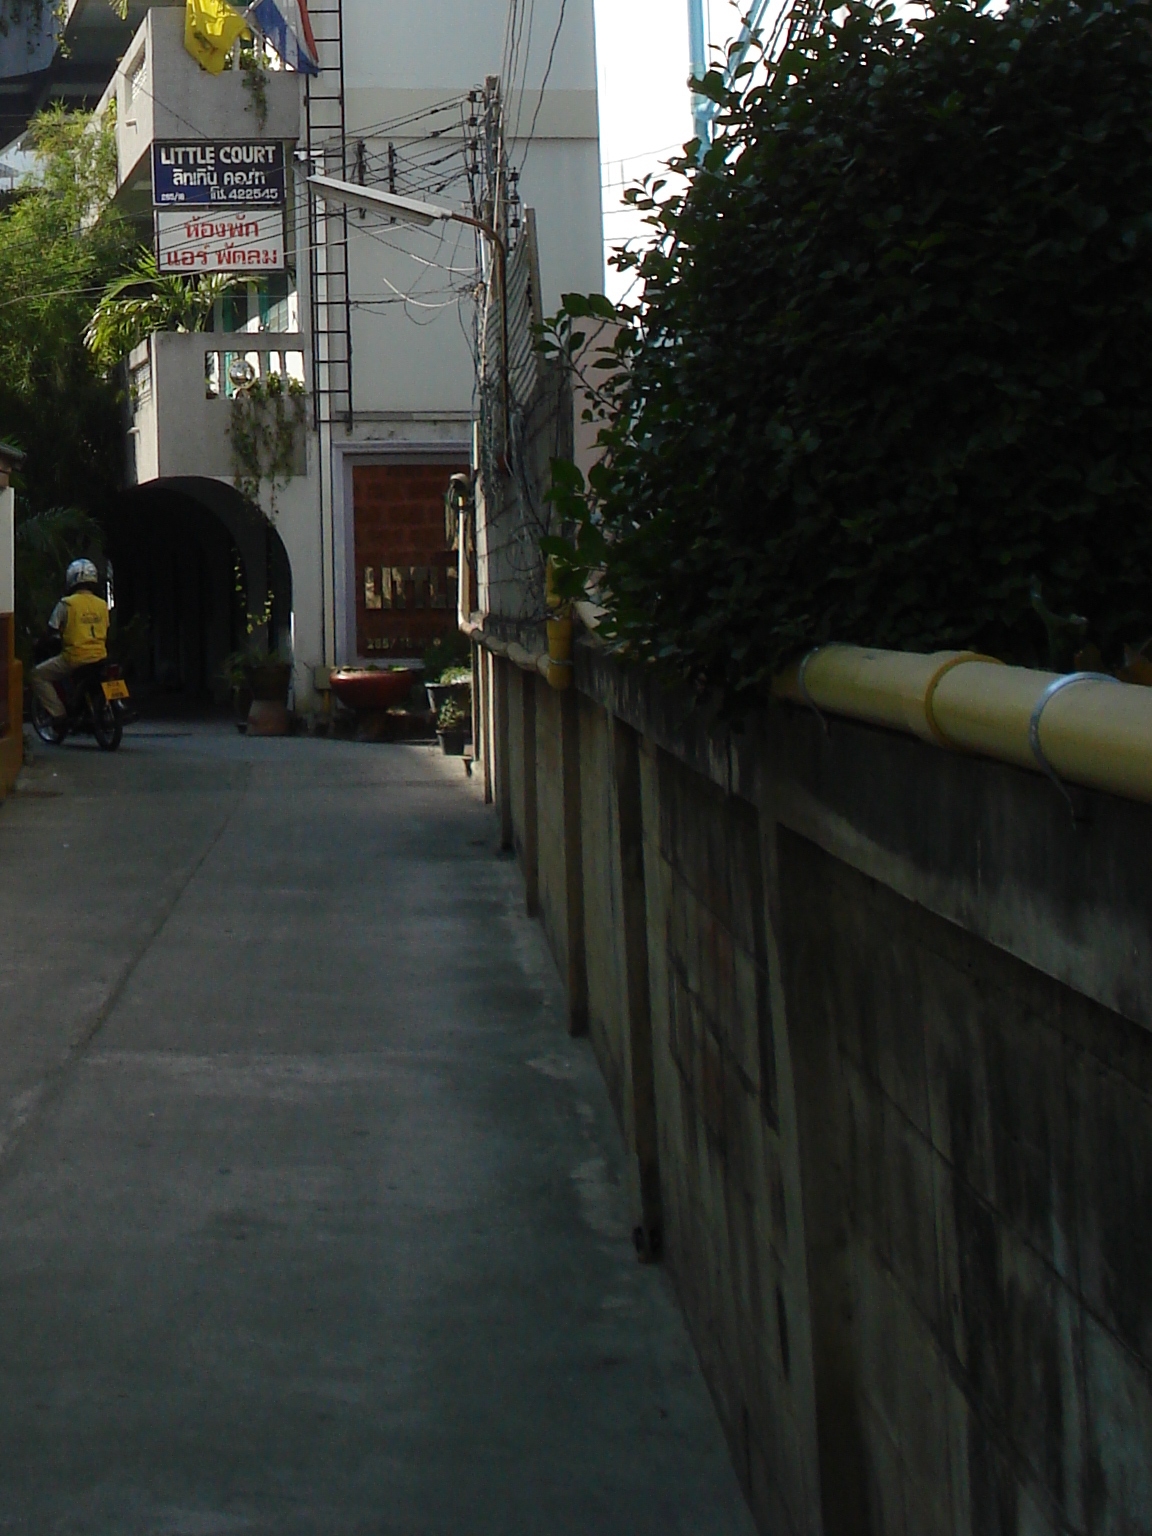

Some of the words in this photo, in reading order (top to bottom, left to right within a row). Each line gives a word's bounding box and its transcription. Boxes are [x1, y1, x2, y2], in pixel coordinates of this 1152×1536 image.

[160, 146, 215, 165] LITTLE
[219, 145, 276, 164] COURT
[228, 188, 278, 200] 422545
[183, 214, 260, 238] ห้องพัก
